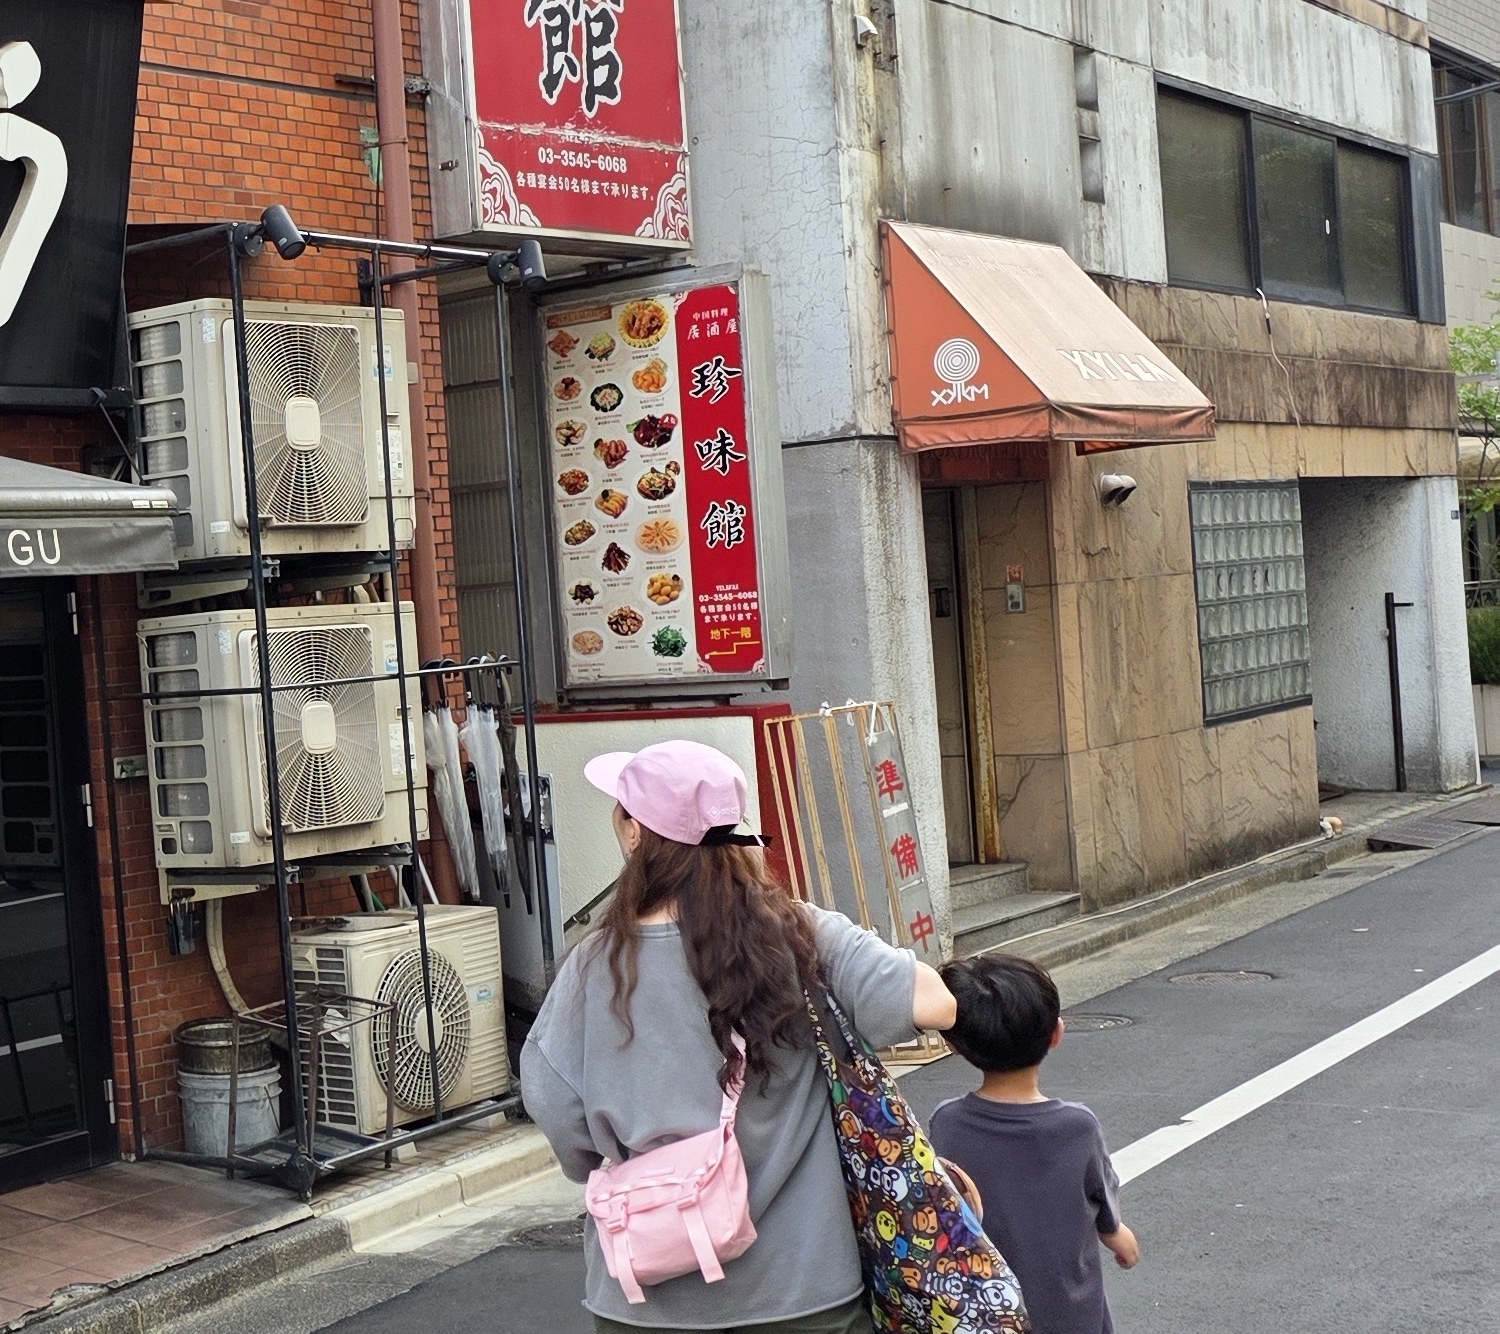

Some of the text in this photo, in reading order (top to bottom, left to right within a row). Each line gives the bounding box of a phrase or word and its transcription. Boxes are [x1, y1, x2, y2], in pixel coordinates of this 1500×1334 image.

[537, 146, 628, 174] 03-3545-6068
[516, 170, 655, 202] 各種宴会50名様まで承ります。
[687, 318, 739, 341] 居酒屋
[688, 356, 747, 549] 珍味館
[7, 528, 62, 566] GU
[698, 590, 758, 603] 03-3545-6068
[710, 626, 752, 640] 地下一階
[874, 758, 936, 955] 準備中
